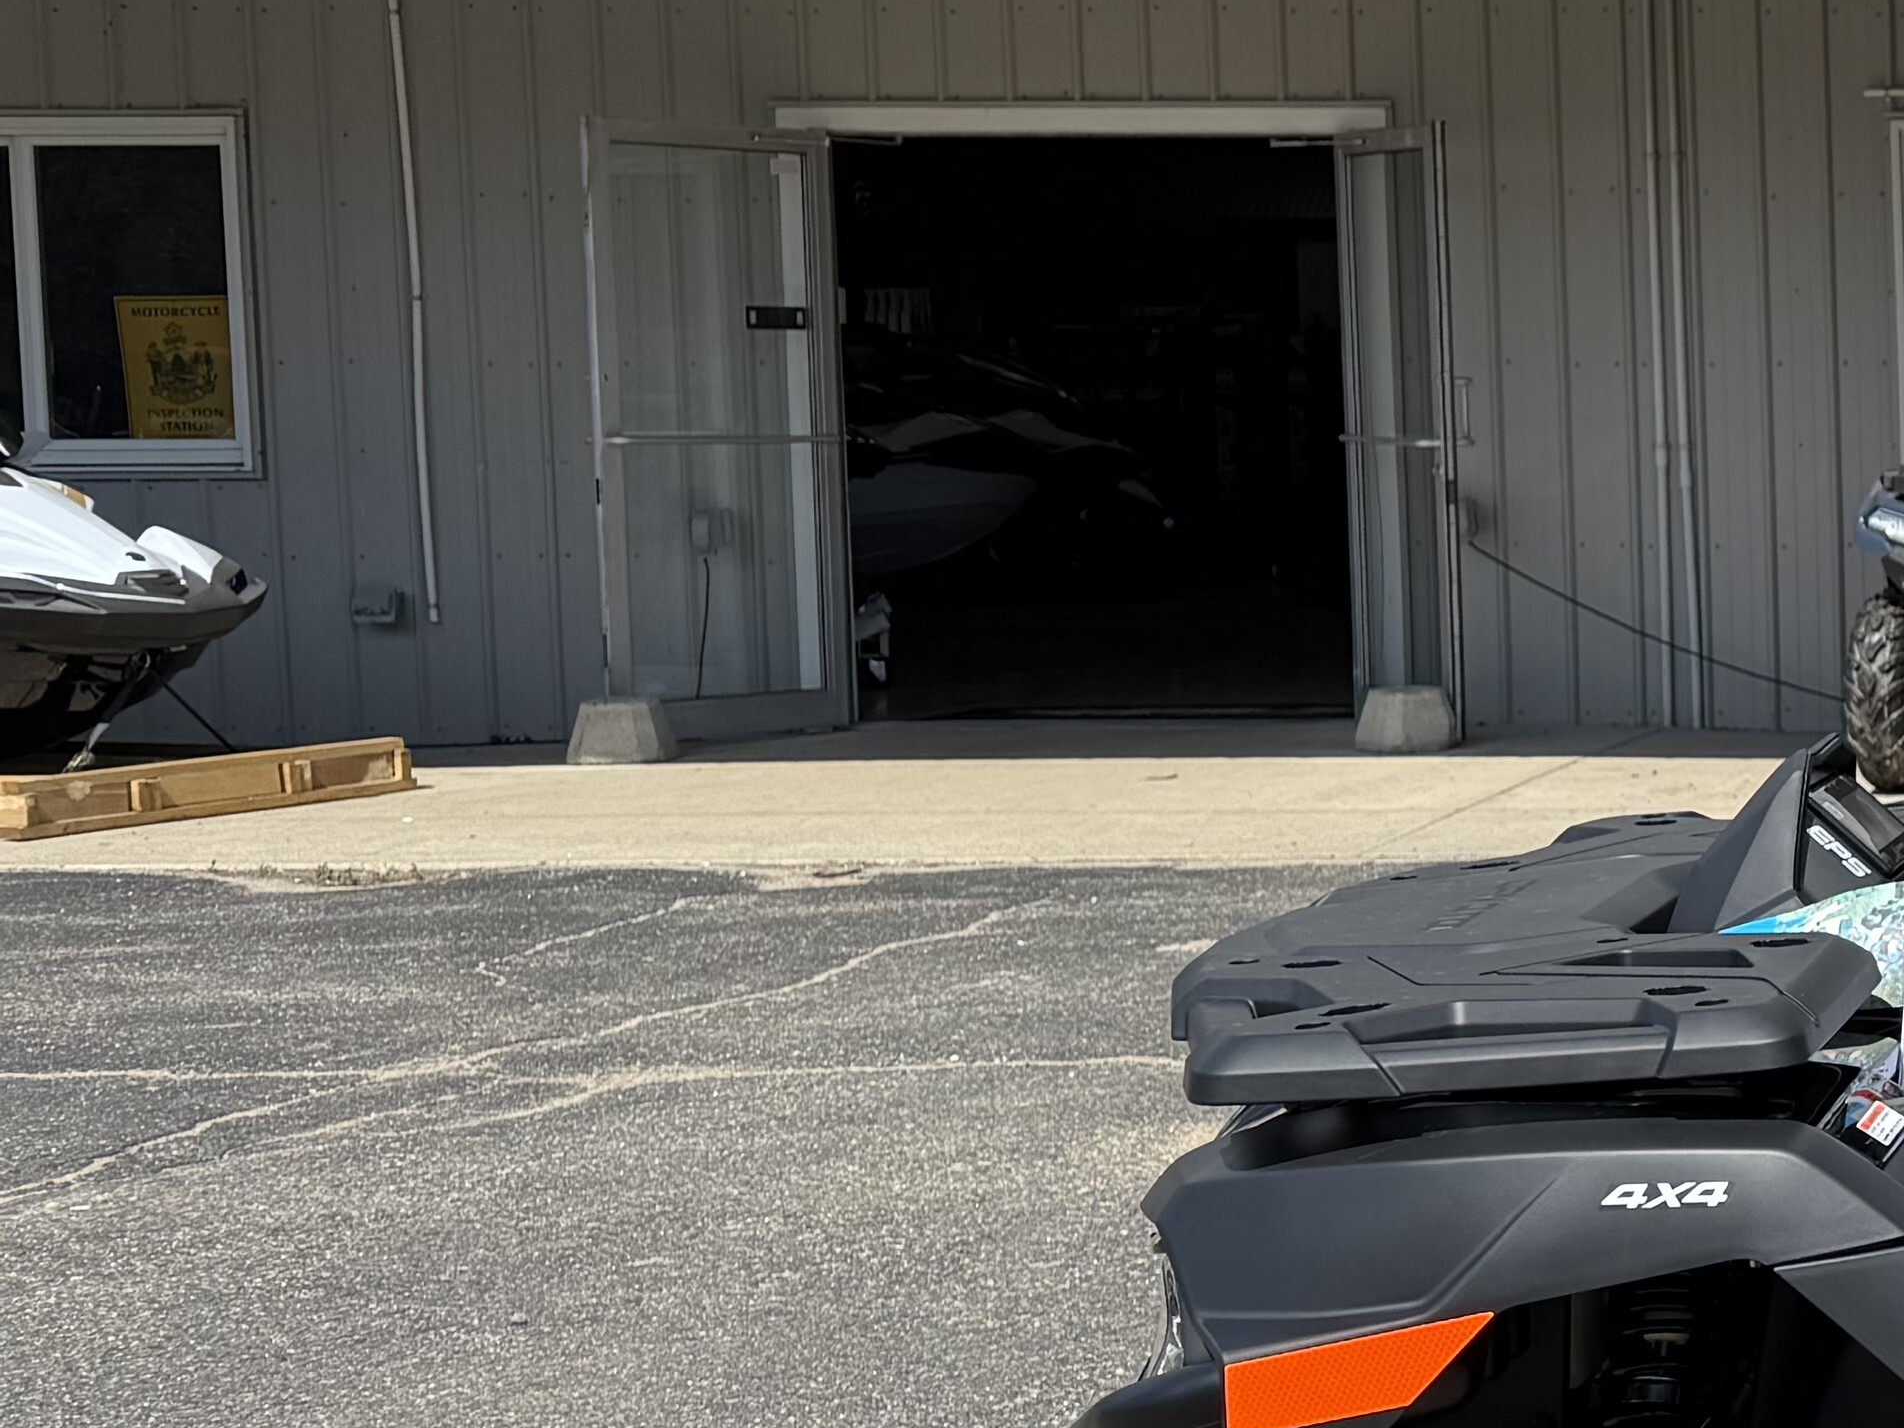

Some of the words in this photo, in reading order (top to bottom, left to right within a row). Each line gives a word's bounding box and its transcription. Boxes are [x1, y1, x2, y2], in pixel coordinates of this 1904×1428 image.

[131, 306, 221, 318] MOTORCYCLE
[147, 407, 225, 419] INSPECTION
[160, 421, 214, 432] STATION
[1805, 824, 1873, 878] EPS
